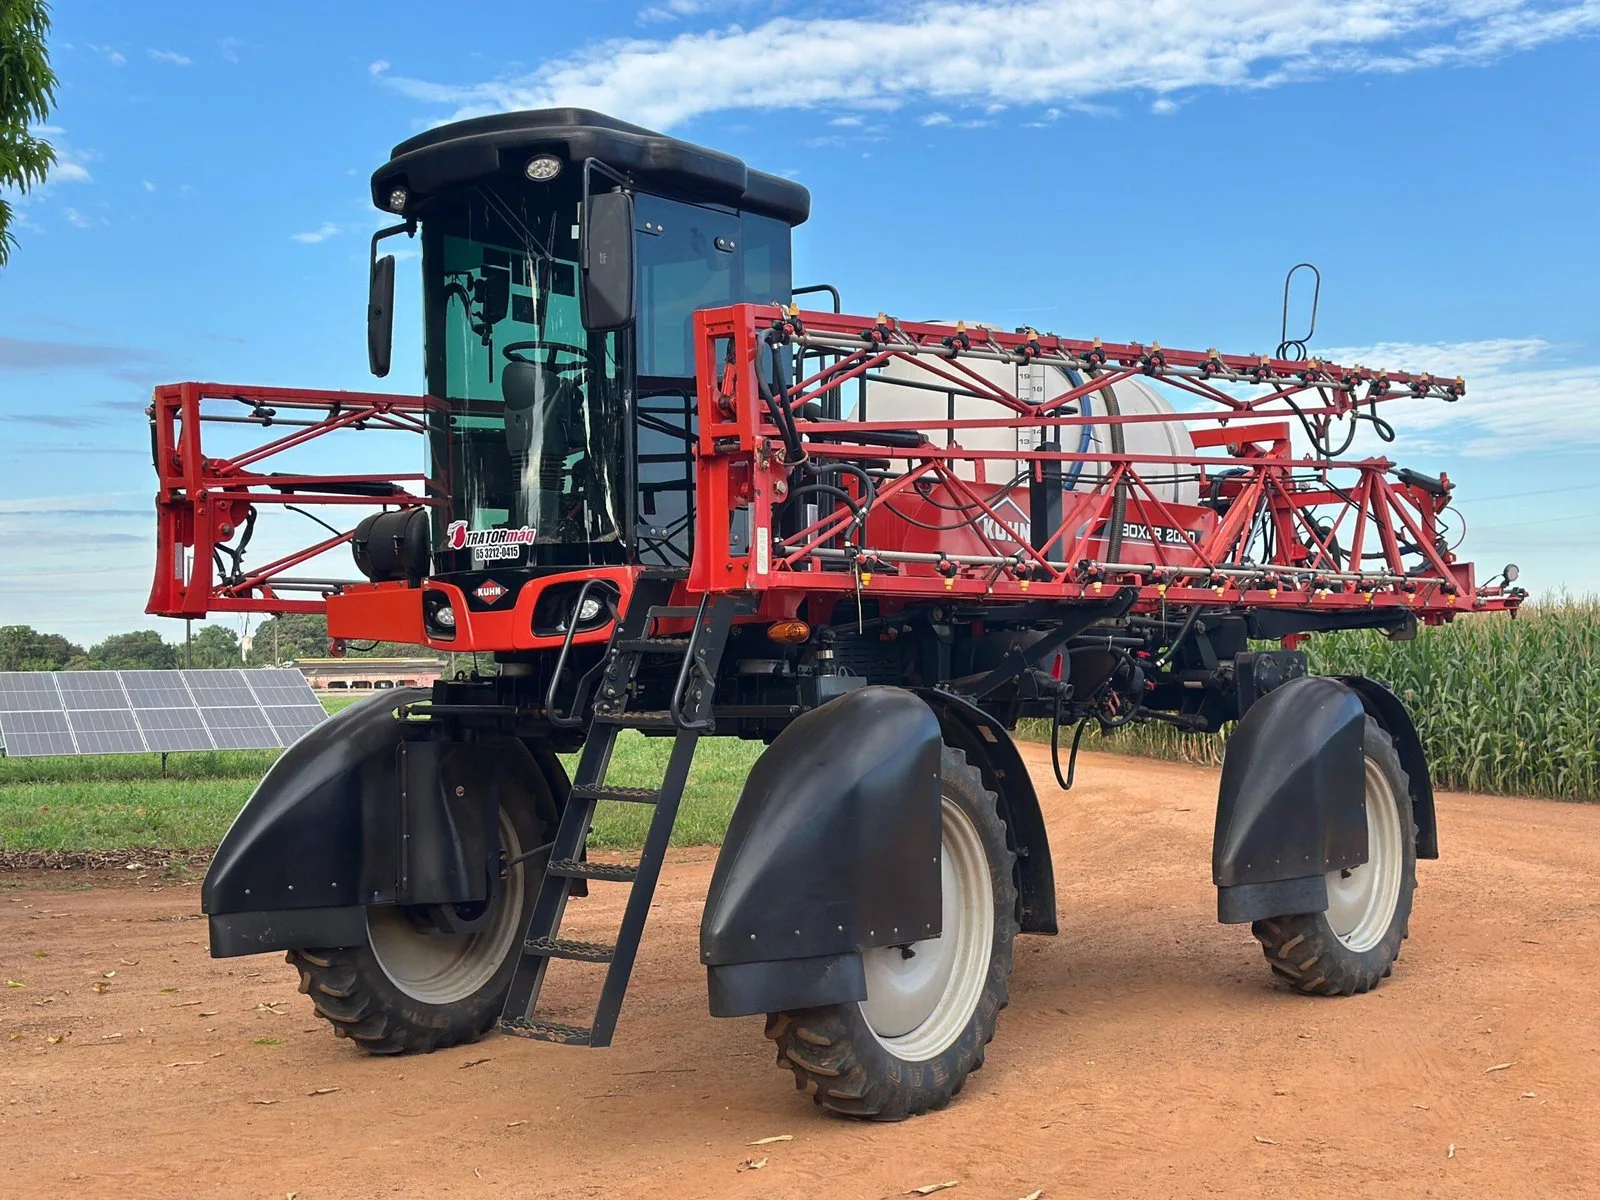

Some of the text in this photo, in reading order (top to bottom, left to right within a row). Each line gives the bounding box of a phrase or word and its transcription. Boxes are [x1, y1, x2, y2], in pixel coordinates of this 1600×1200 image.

[466, 527, 535, 546] TRATORmáq
[983, 518, 1031, 545] KUHN
[475, 546, 518, 559] 65 3212-0415
[477, 587, 501, 597] KUHN
